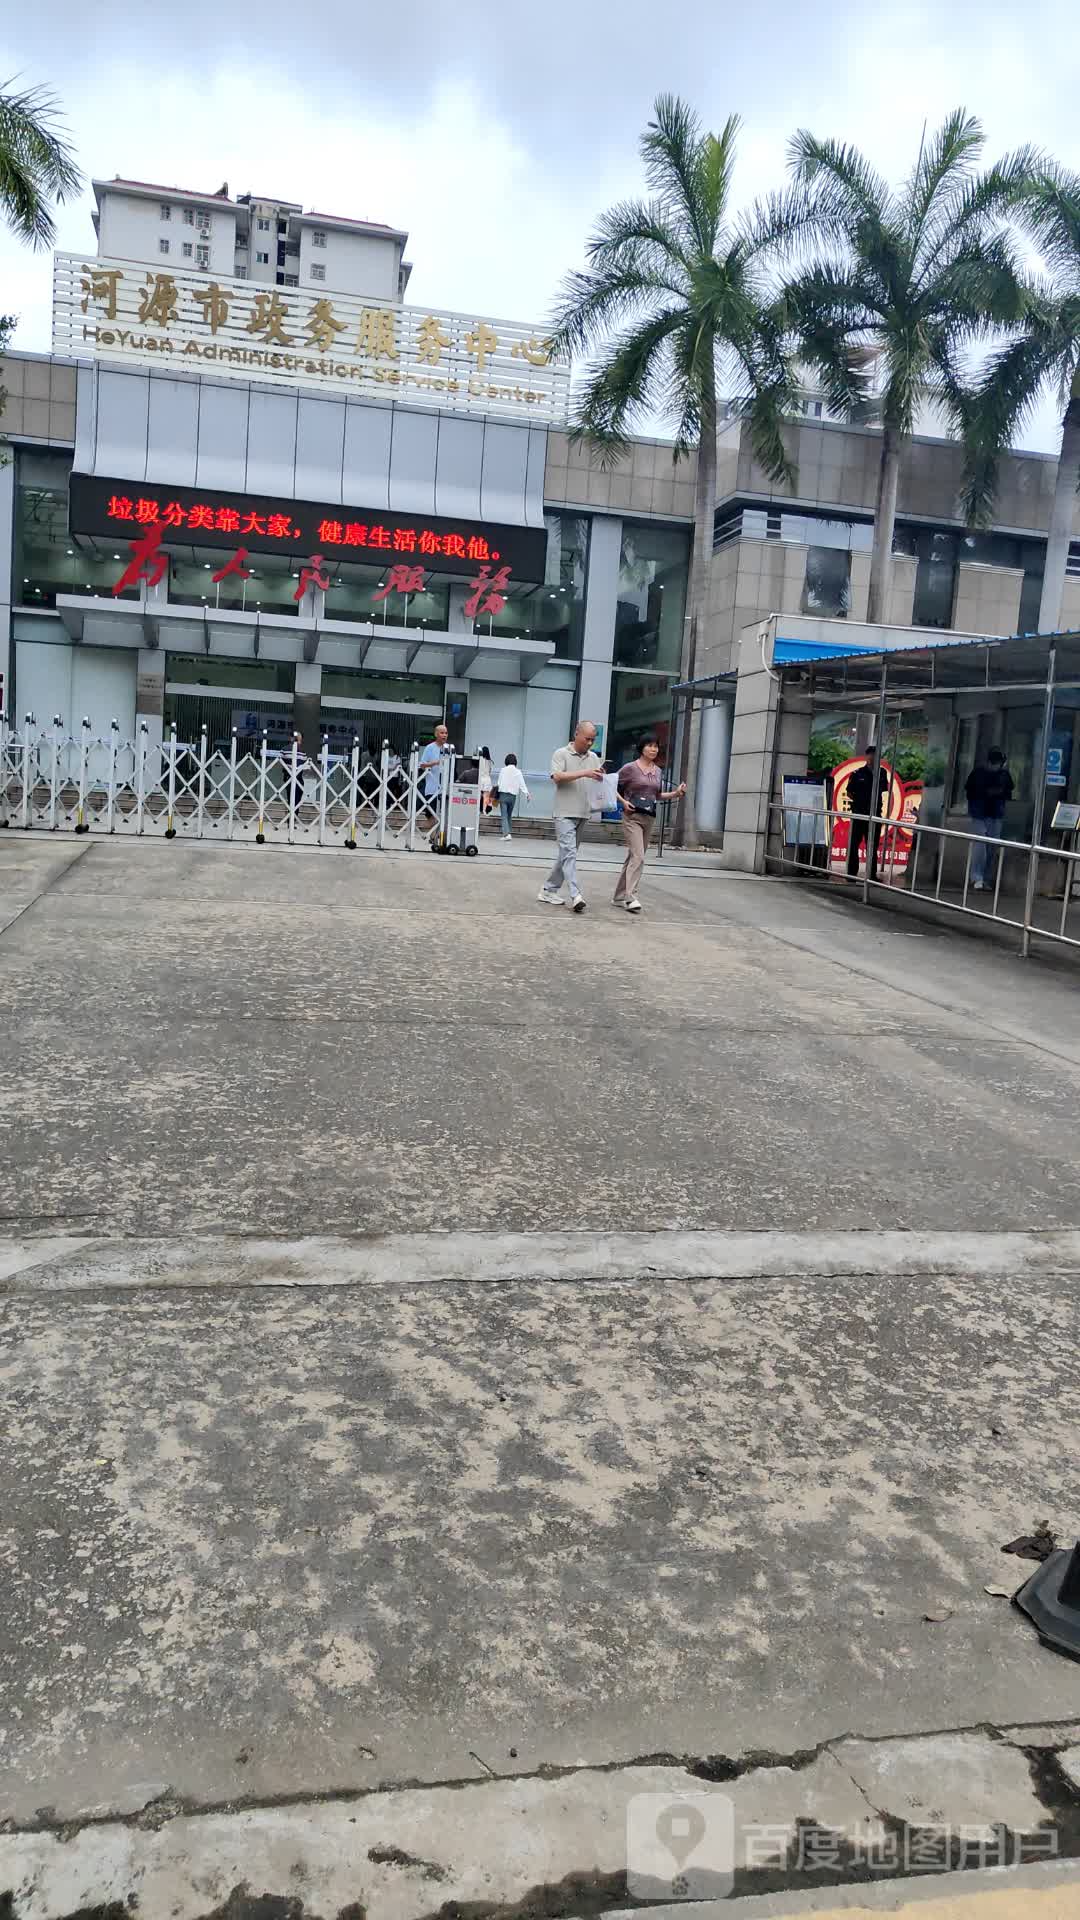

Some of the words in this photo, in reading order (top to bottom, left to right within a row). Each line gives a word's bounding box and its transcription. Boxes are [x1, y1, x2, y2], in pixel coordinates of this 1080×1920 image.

[80, 263, 554, 369] 河源市政务服务中心
[82, 325, 174, 353] HeYuan
[183, 340, 363, 380] Administration
[375, 366, 460, 393] Service
[468, 377, 546, 405] Center
